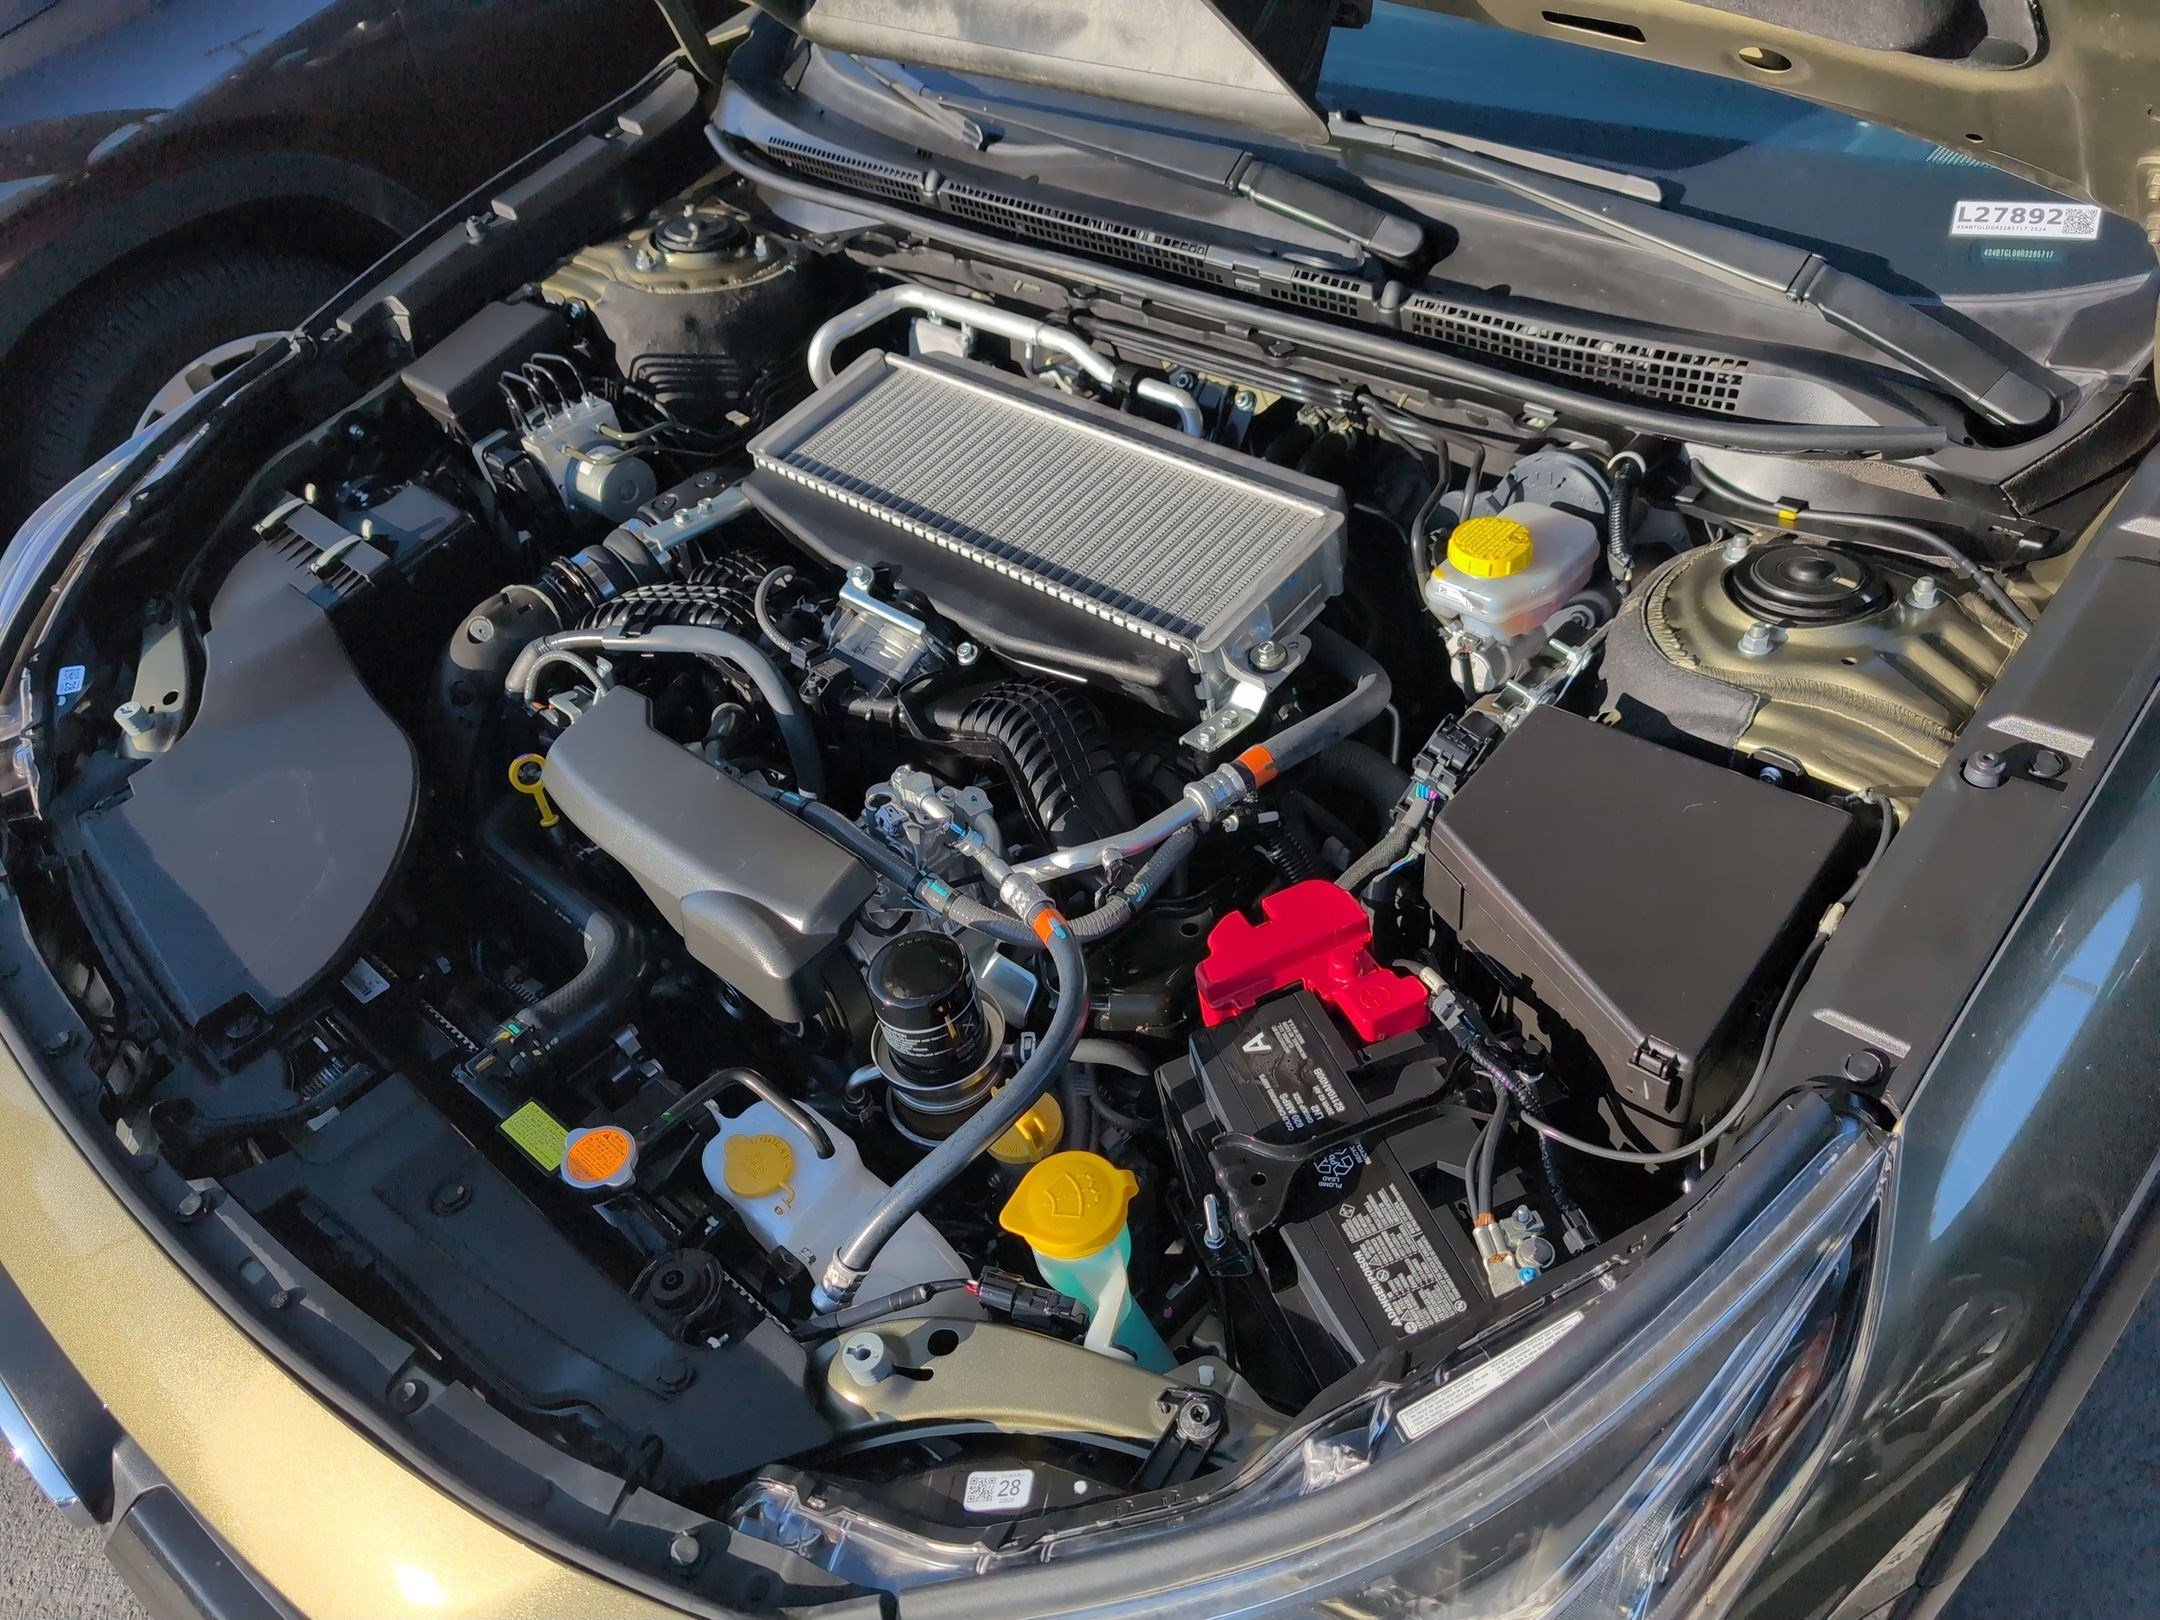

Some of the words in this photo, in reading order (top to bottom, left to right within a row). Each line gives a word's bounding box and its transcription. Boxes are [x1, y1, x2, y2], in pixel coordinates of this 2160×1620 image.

[1958, 206, 2063, 225] L27892
[1241, 1030, 1272, 1053] A
[1258, 1073, 1271, 1089] AMPS
[1266, 1087, 1286, 1116] CRANKING
[1278, 1092, 1297, 1115] AMPS
[1290, 1113, 1304, 1128] 620
[1299, 1103, 1314, 1122] GROUP
[1310, 1103, 1324, 1120] LN2
[1282, 1115, 1295, 1131] COLD
[1321, 1175, 1340, 1183] LEAD
[1352, 1249, 1397, 1320] DANGER/POISON
[997, 1479, 1021, 1497] 28
